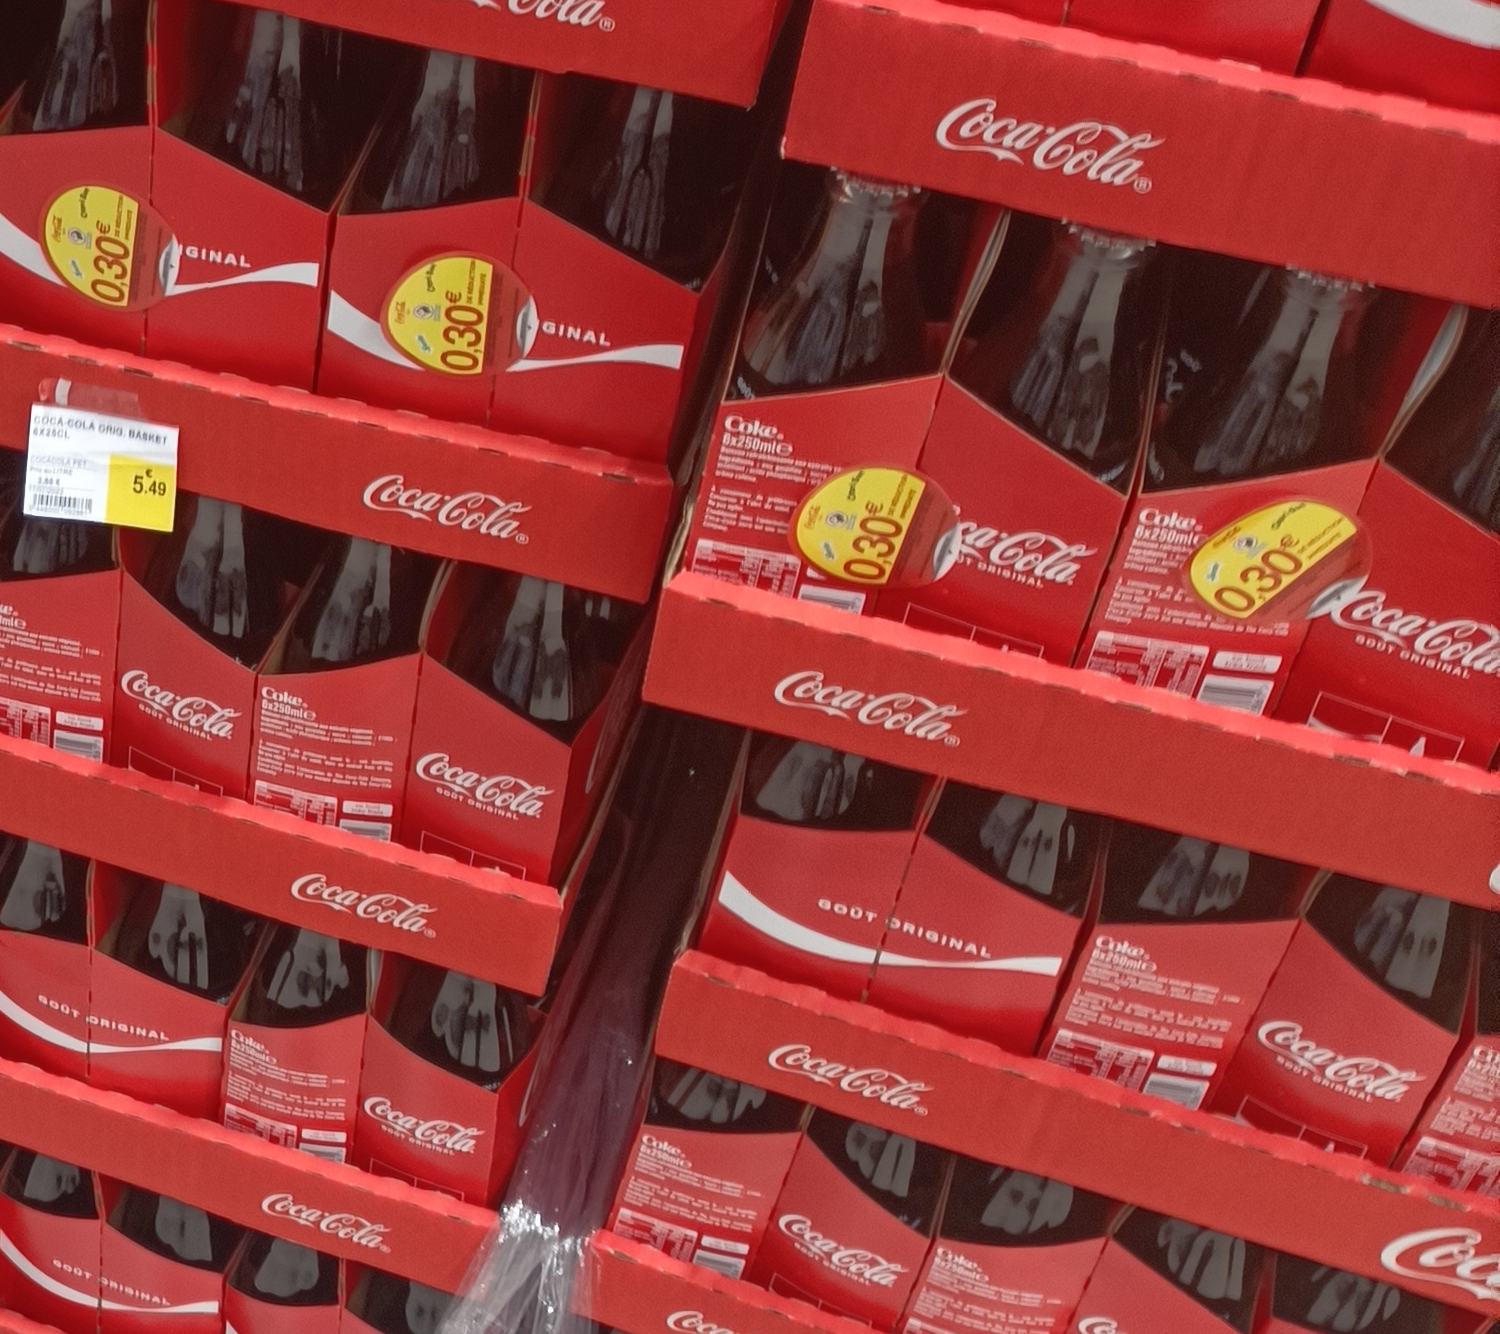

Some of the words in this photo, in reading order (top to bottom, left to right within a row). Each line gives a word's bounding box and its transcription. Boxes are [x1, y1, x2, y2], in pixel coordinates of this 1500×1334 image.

[935, 97, 1167, 187] Coca-Cola
[179, 243, 253, 269] IGINAL
[541, 320, 612, 348] GINAL
[128, 428, 168, 446] BASKET
[722, 414, 780, 439] Coke
[132, 474, 167, 497] 5.49
[362, 473, 533, 539] Coca-Cola
[1138, 506, 1199, 532] Coke
[977, 559, 1045, 590] ORIGINAL
[1398, 650, 1472, 680] ORIGINAL
[121, 669, 243, 740] Coca-Cola
[261, 685, 304, 707] Coke
[773, 670, 969, 742] Coca-Cola
[415, 751, 555, 818] Coca-Cola
[290, 873, 438, 934] Coca-Cola
[817, 897, 878, 924] GOÛT
[886, 916, 993, 960] ORIGINAL
[37, 993, 82, 1019] GOÛT
[86, 1014, 171, 1043] ORIGINAL
[768, 1043, 935, 1113] Coca-Cola
[1257, 1020, 1428, 1101] Coca-Cola
[363, 1096, 486, 1154] Coca-Cola
[261, 1192, 392, 1251] Coca-Cola
[777, 1214, 909, 1289] Coca-Cola
